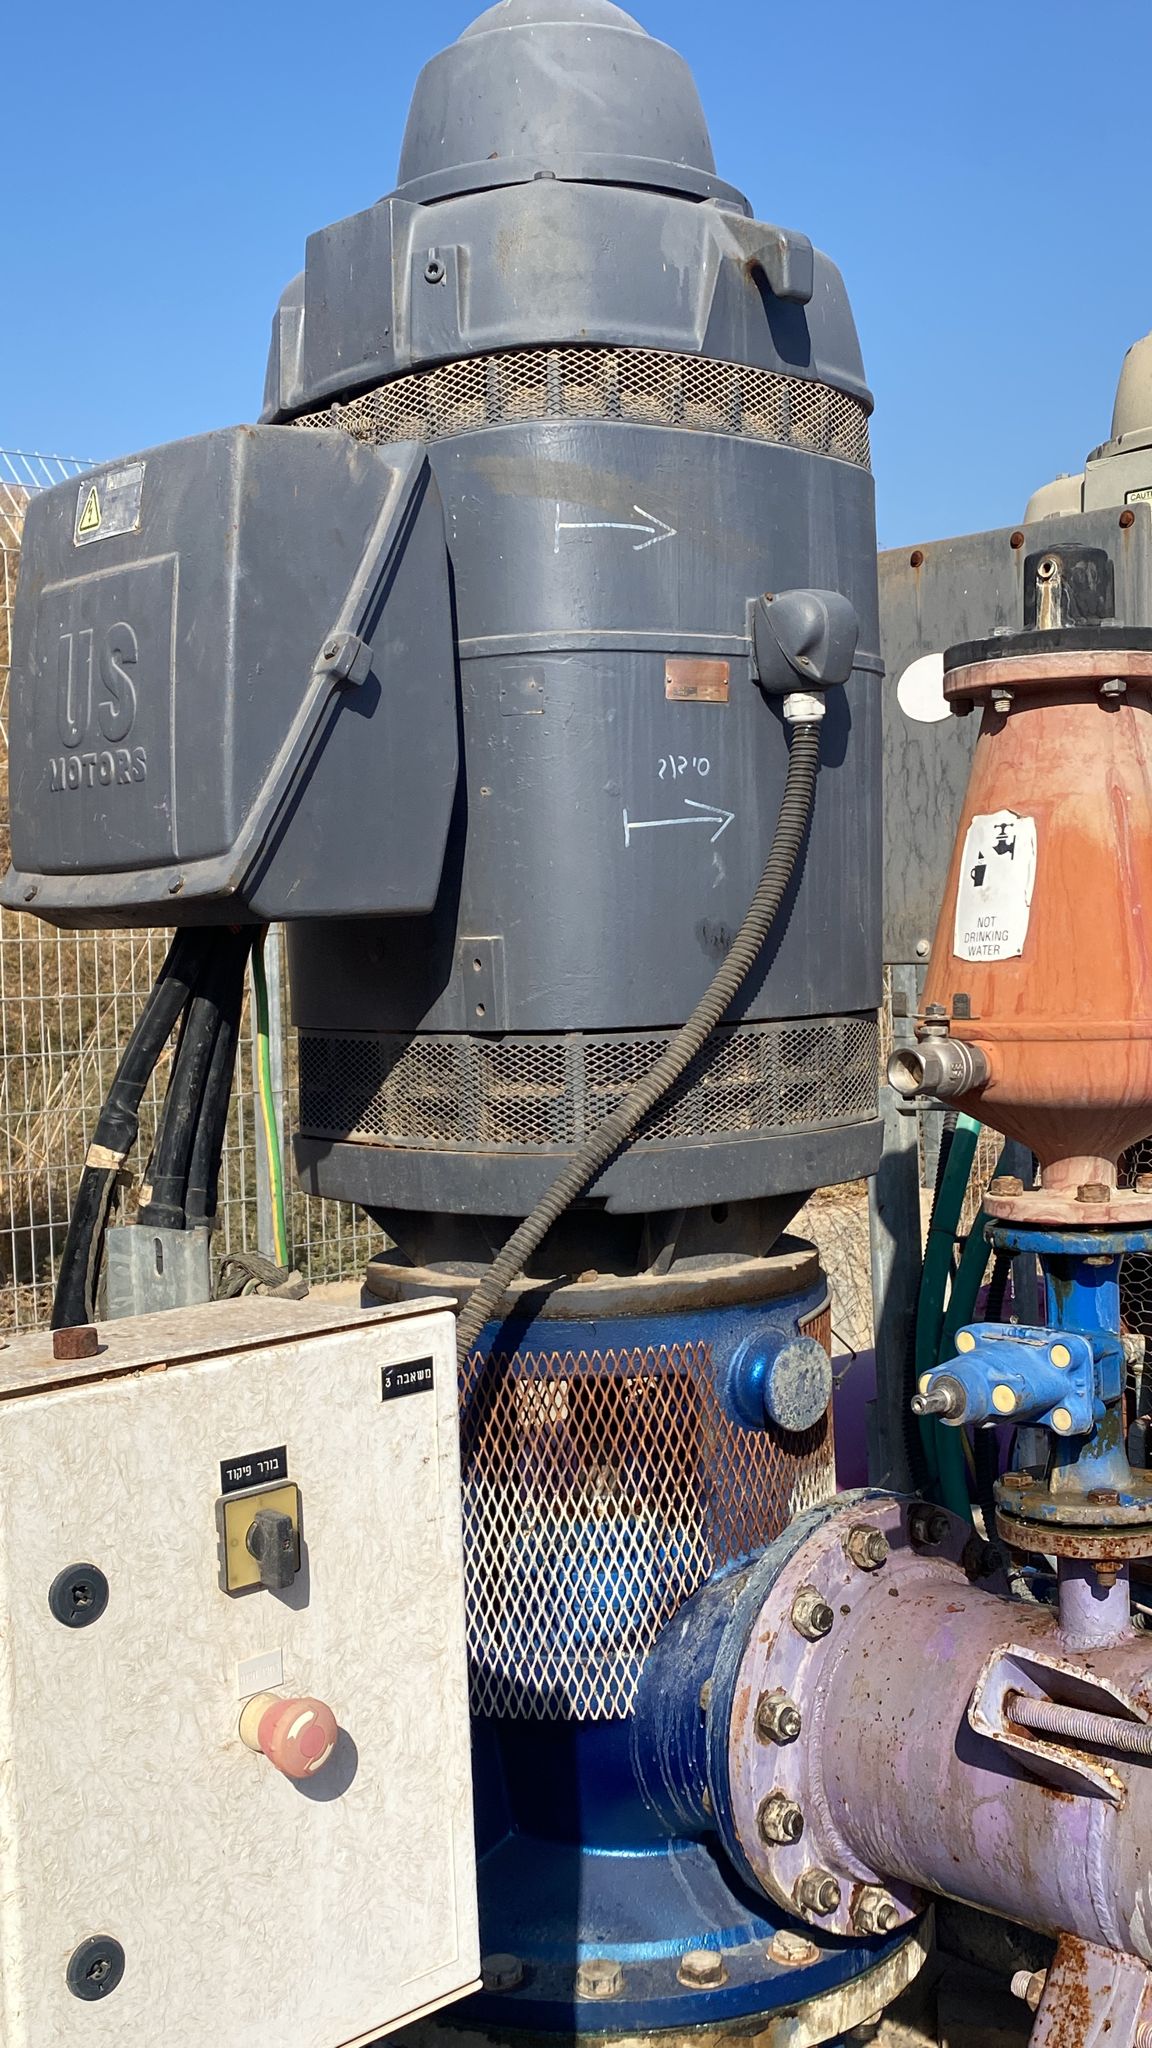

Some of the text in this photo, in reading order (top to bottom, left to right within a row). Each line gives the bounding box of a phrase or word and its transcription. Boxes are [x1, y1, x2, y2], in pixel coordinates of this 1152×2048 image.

[57, 622, 139, 749] US
[49, 747, 147, 792] MOTORS
[977, 916, 997, 928] NOT
[964, 930, 1009, 944] DRINKING
[968, 944, 1000, 957] WATER
[385, 1368, 431, 1388] משאבה 3
[226, 1458, 279, 1481] בורר פיקוד
